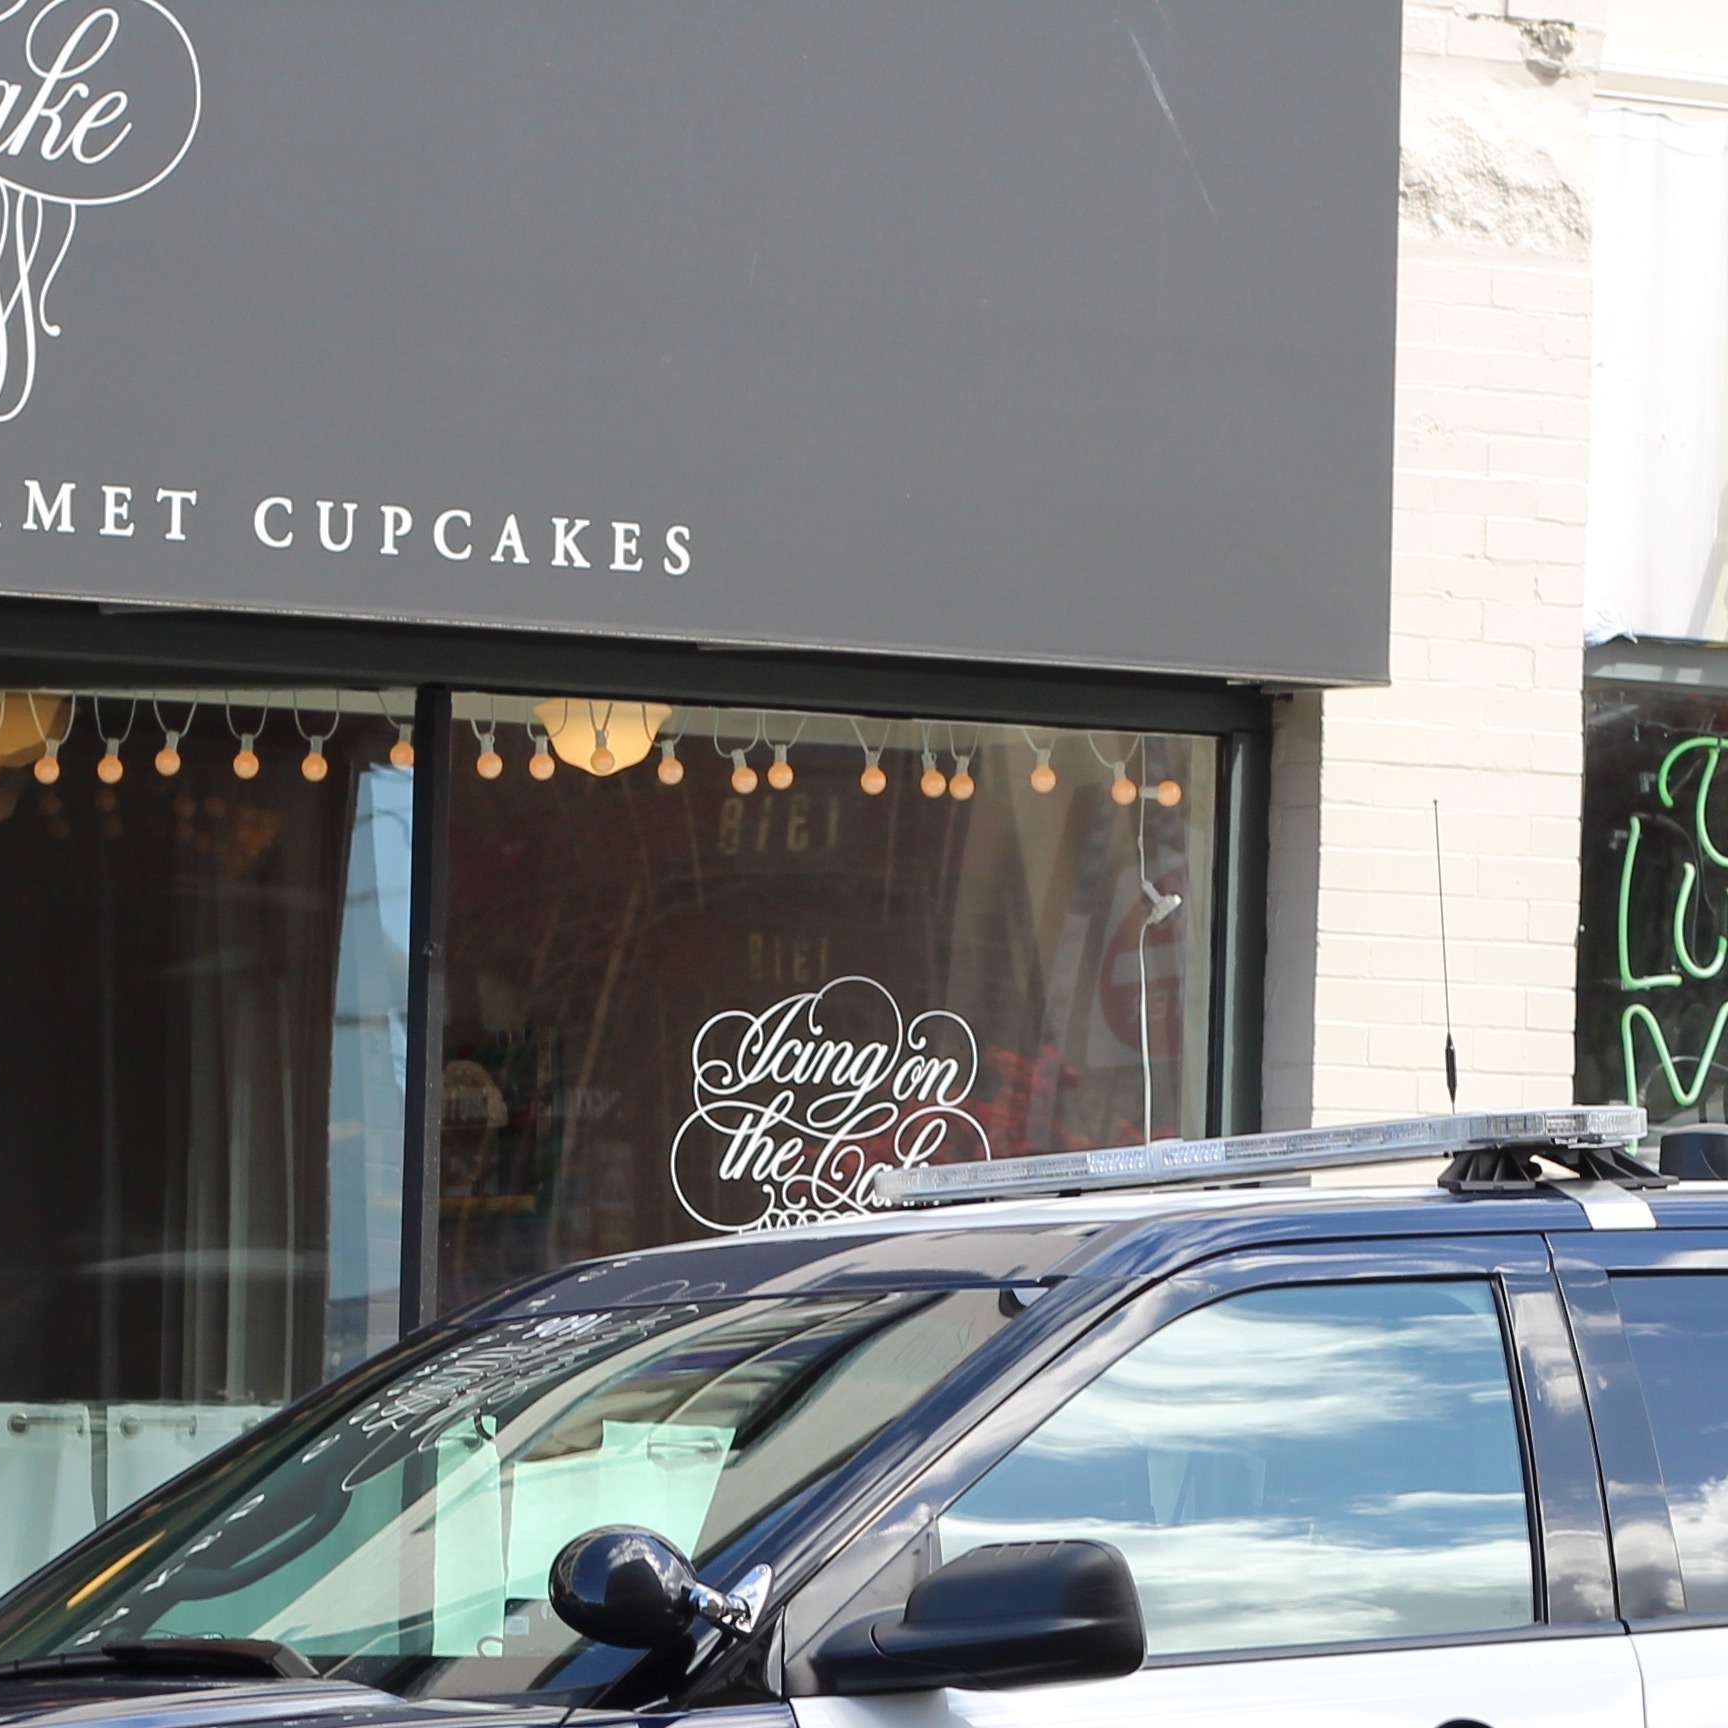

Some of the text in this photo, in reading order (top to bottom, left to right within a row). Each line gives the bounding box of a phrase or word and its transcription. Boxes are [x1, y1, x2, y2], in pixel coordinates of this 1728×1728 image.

[254, 496, 692, 576] CUPCAKES
[704, 986, 969, 1128] Icing on
[719, 1090, 806, 1182] the
